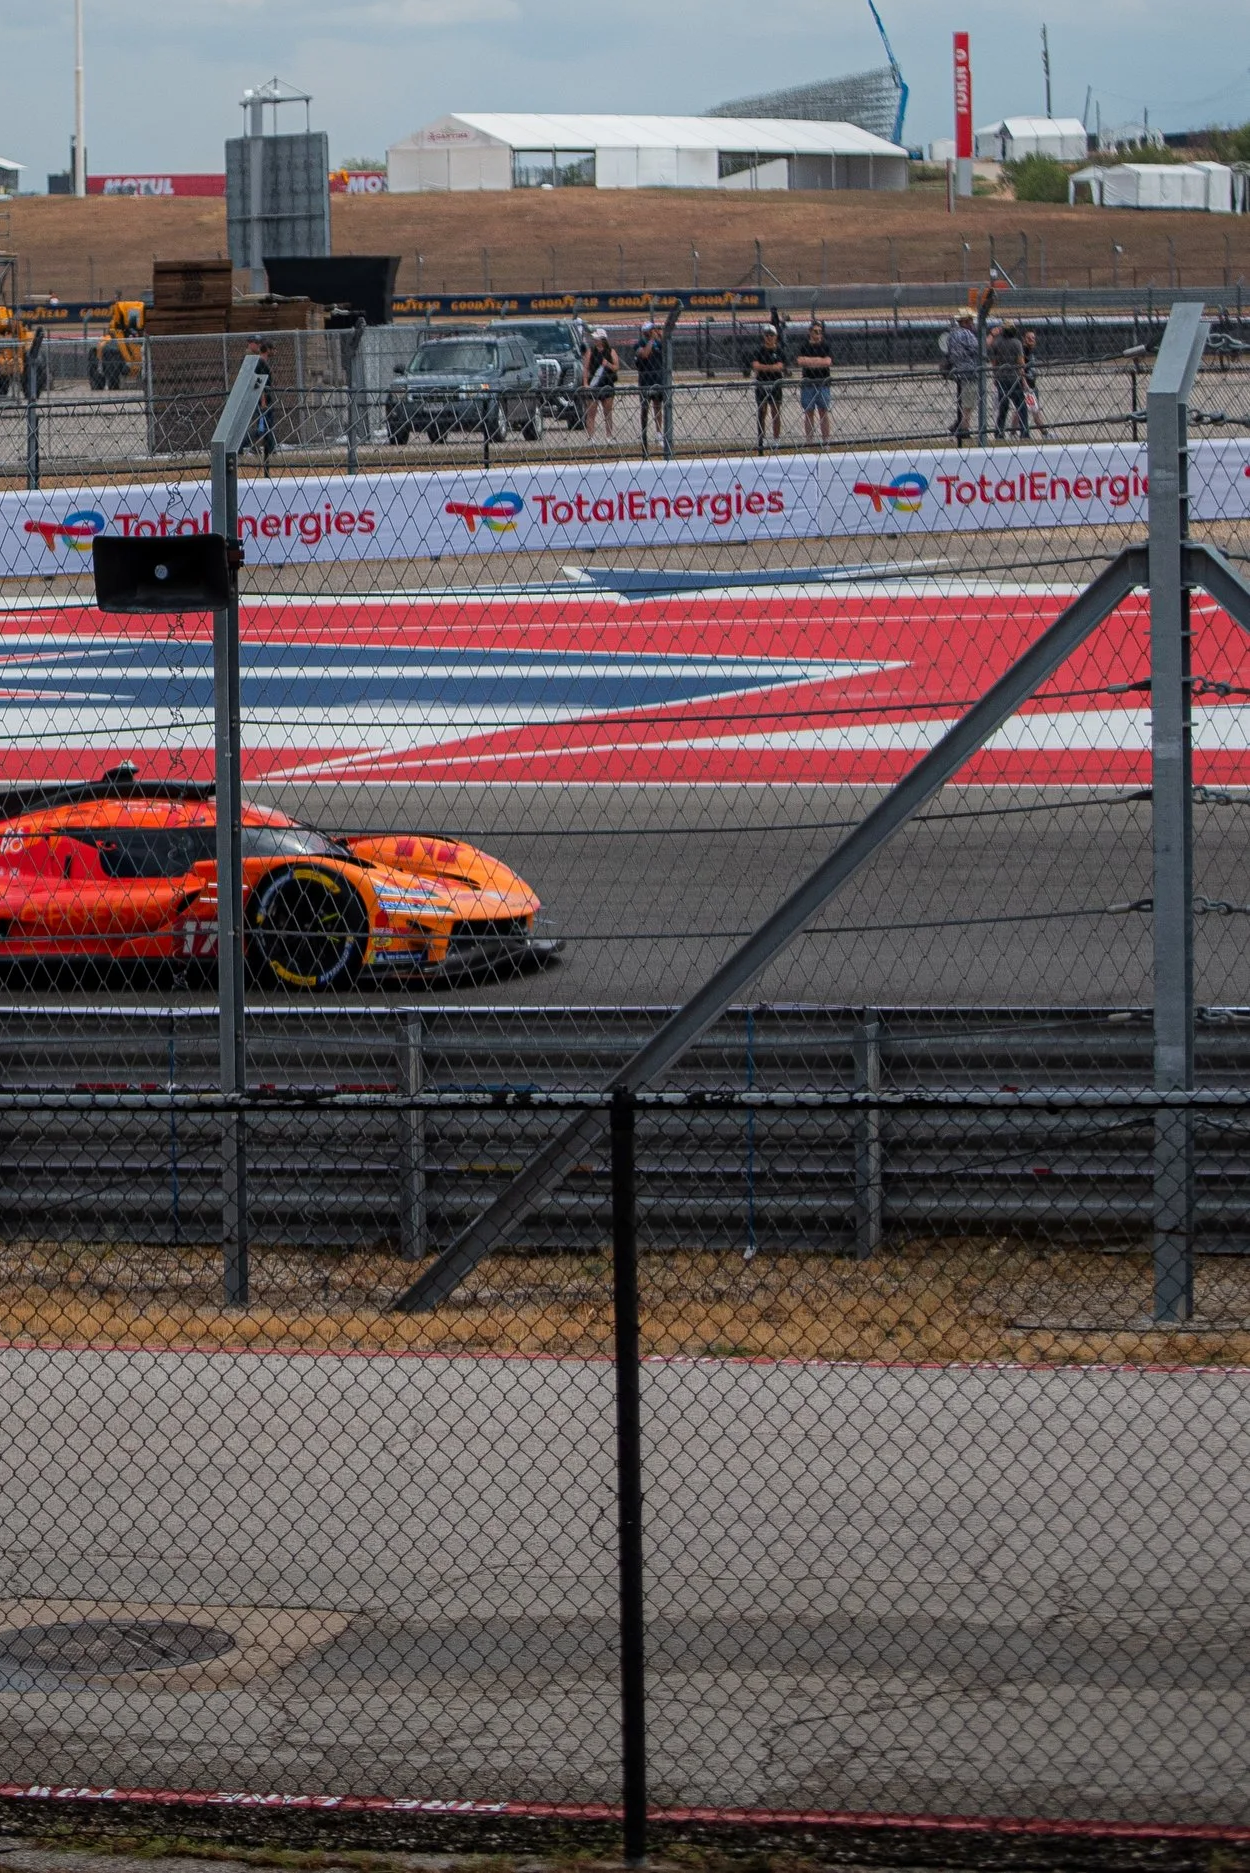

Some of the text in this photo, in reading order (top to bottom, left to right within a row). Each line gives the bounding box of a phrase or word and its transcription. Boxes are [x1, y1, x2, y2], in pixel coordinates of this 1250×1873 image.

[103, 177, 175, 195] MOTUL
[533, 482, 784, 526] TotalEnergies
[937, 465, 1149, 507] TotalEnergi
[114, 502, 376, 545] Totalnergies
[183, 921, 219, 953] 17
[385, 1798, 508, 1812] FIRE
